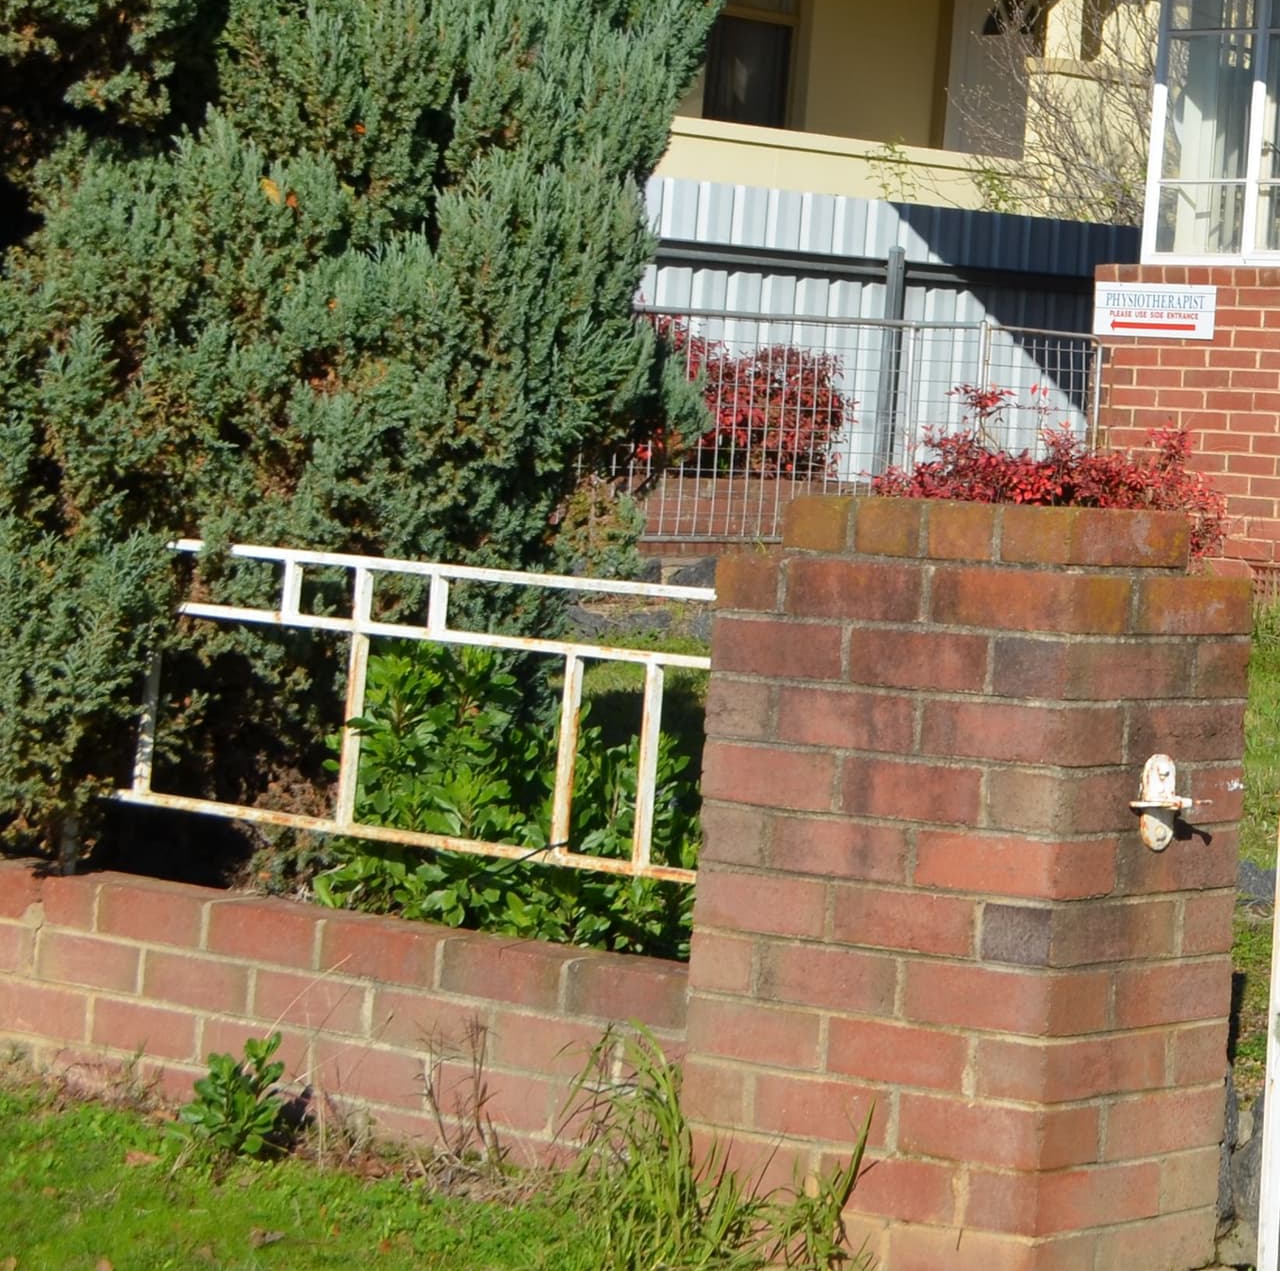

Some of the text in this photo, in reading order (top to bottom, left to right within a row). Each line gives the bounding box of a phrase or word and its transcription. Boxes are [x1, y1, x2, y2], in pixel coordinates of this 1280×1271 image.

[1105, 292, 1205, 310] PHYSIOTHERAPIST
[1109, 310, 1199, 320] PLEASE USE SIDE ENTRANCE
